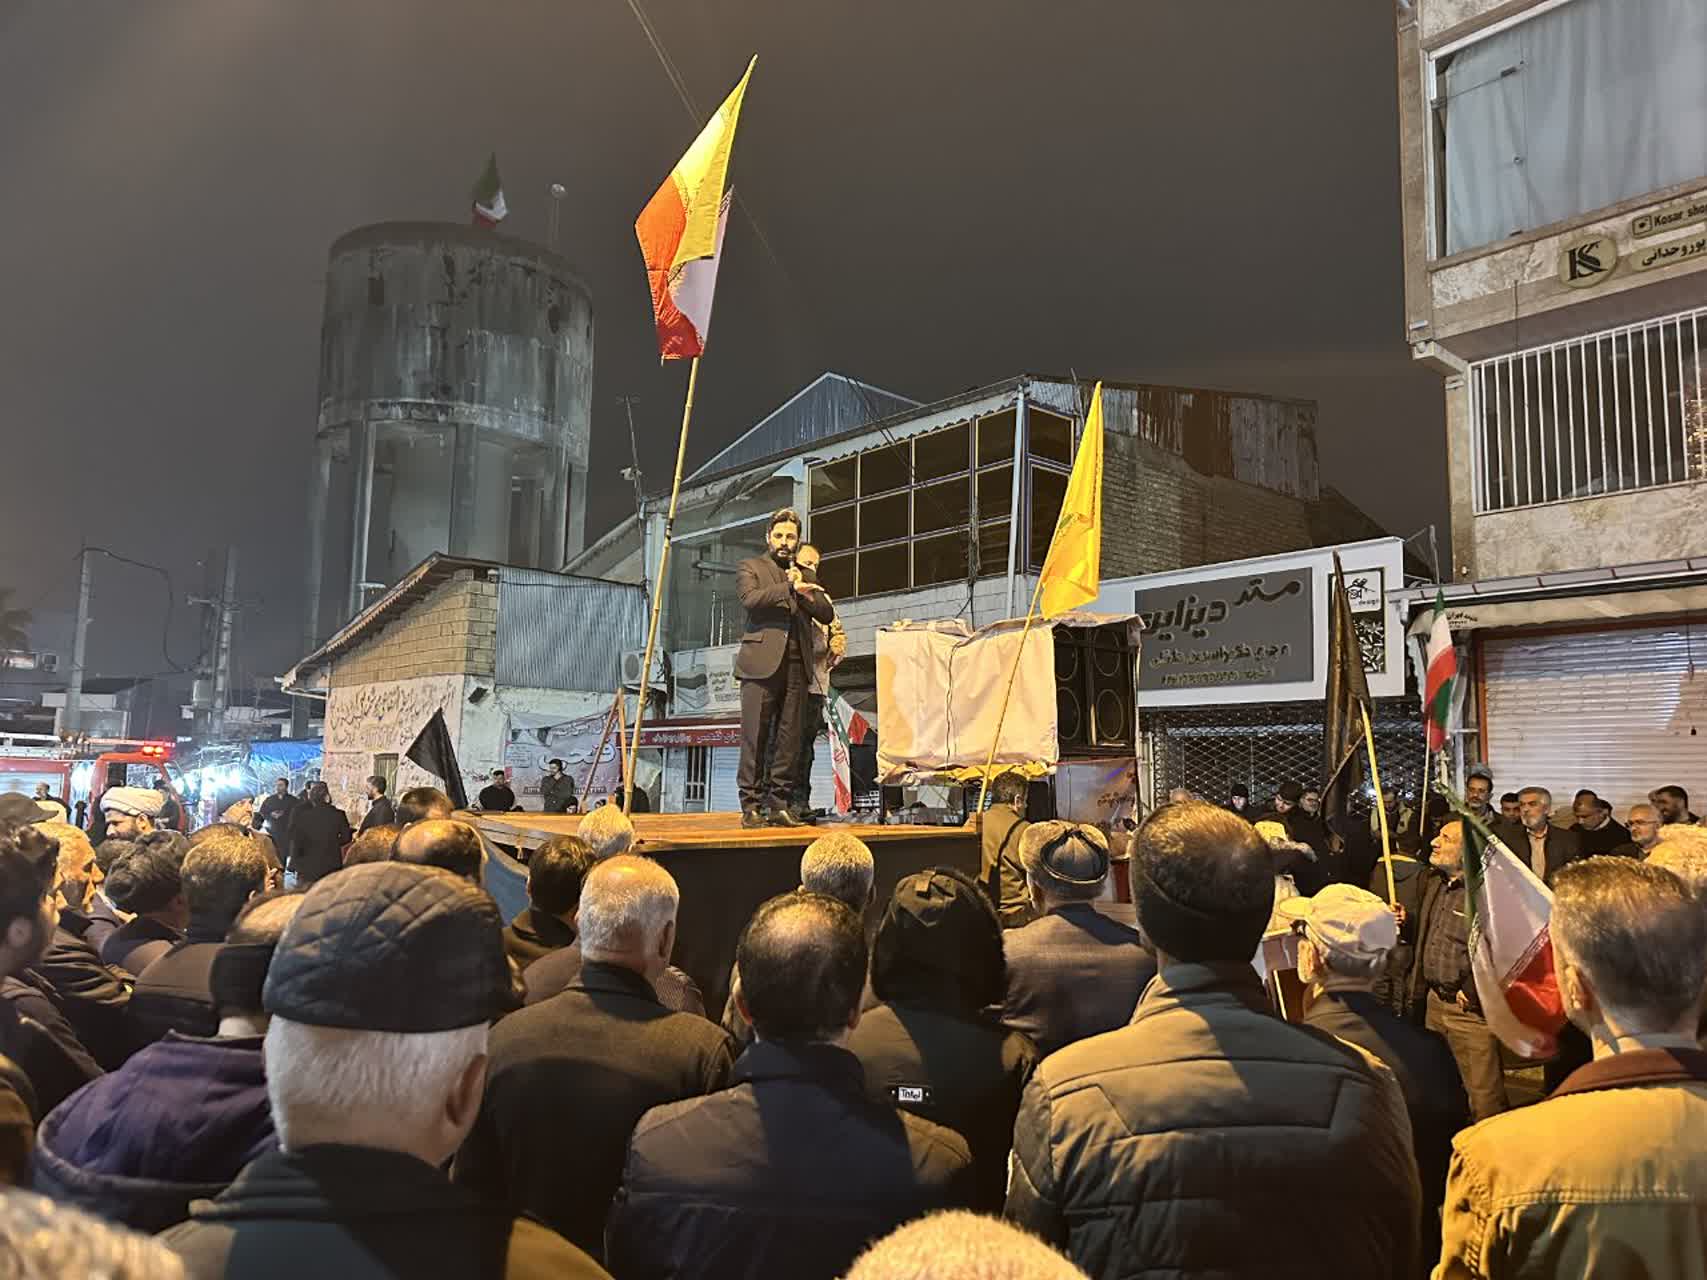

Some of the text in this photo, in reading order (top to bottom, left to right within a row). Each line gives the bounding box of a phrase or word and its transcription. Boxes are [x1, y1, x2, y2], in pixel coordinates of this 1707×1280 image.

[1653, 204, 1707, 227] Kosar sho
[1233, 578, 1303, 607] متر
